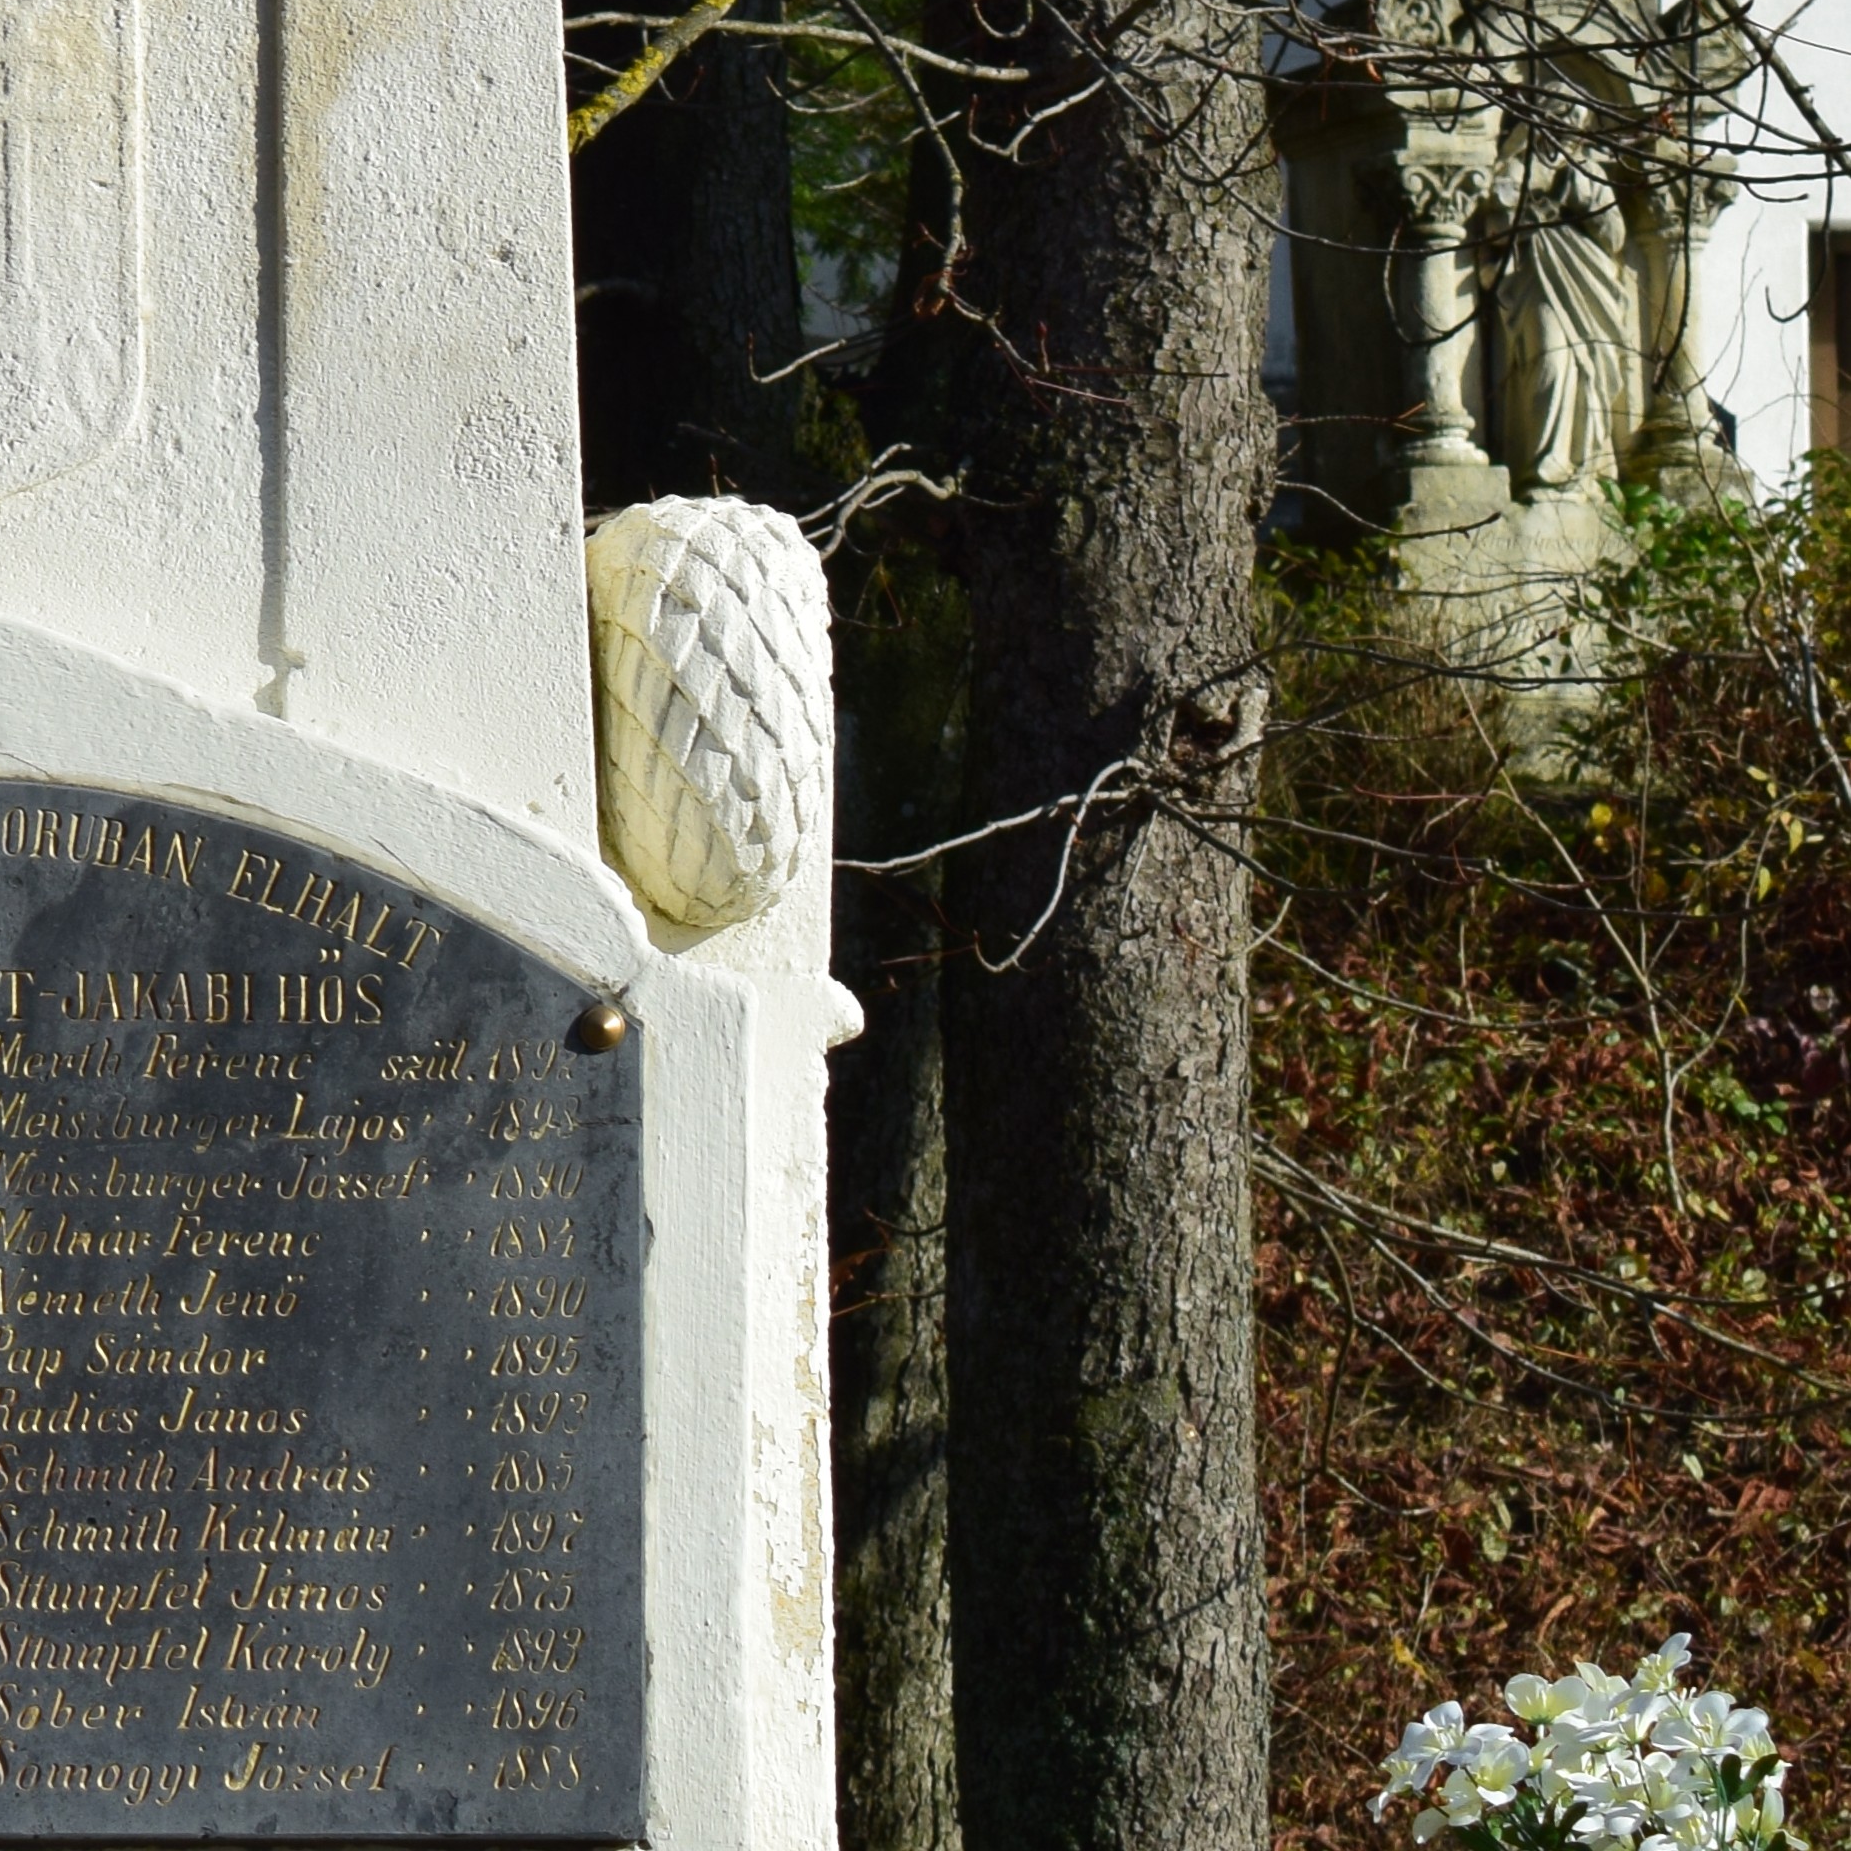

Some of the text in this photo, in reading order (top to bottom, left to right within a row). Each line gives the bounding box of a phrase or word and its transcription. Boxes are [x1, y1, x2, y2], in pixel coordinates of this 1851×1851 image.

[225, 849, 444, 971] ELHALT
[143, 1032, 315, 1081] Ferenc
[283, 1091, 412, 1156] Lajos
[277, 1153, 430, 1201] József
[163, 1215, 324, 1258] Ferenc
[490, 1275, 587, 1320] 1890
[86, 1332, 268, 1376] Sándor
[490, 1333, 586, 1377] 1895
[160, 1386, 309, 1435] János
[490, 1391, 589, 1435] 1893
[187, 1446, 376, 1493] András
[196, 1502, 397, 1553] Kálmán
[491, 1508, 585, 1554] 1897
[231, 1562, 390, 1612] János
[223, 1622, 393, 1688] Károly
[491, 1626, 586, 1674] 1893
[177, 1684, 322, 1730] István
[492, 1687, 586, 1730] 1896
[225, 1741, 399, 1793] József
